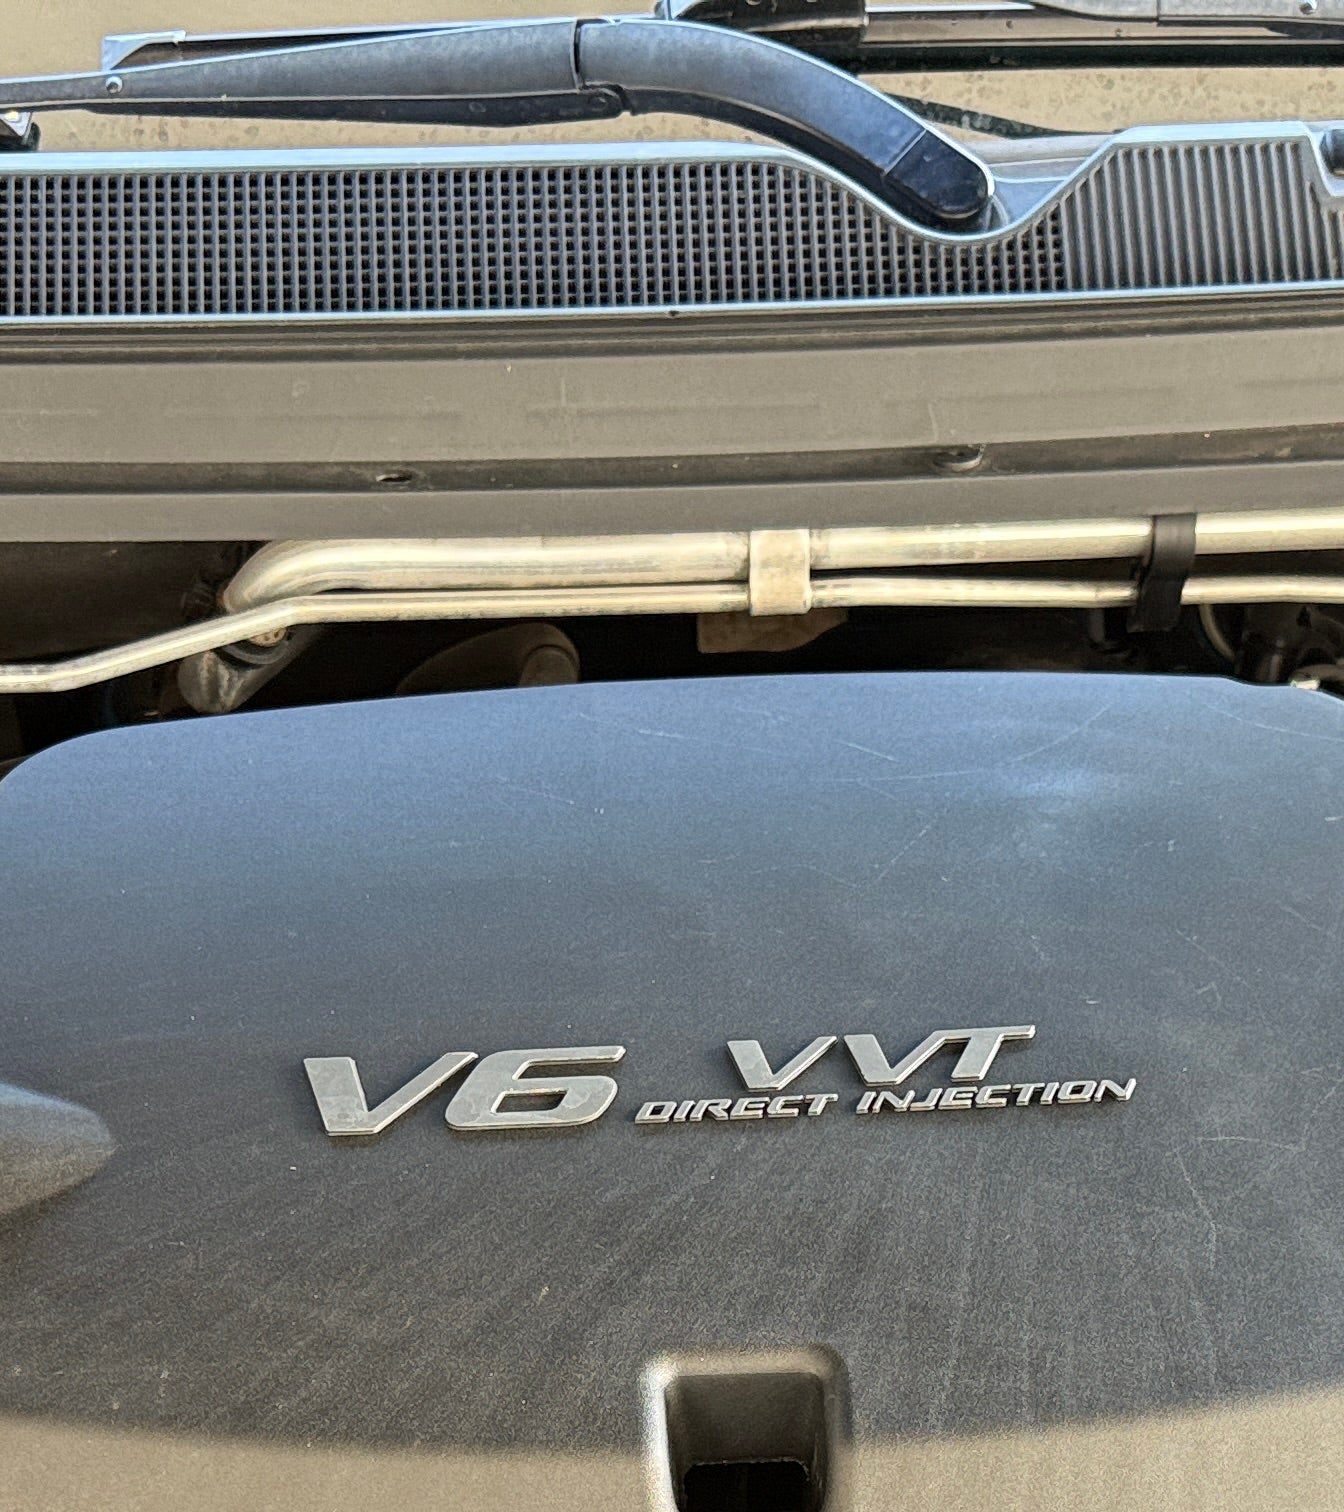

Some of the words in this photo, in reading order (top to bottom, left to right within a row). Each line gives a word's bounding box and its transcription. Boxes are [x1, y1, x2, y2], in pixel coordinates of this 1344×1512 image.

[302, 1045, 627, 1136] V6
[726, 1023, 1037, 1091] VVT
[633, 1091, 840, 1126] DIRECT
[855, 1077, 1139, 1117] INJECTION
